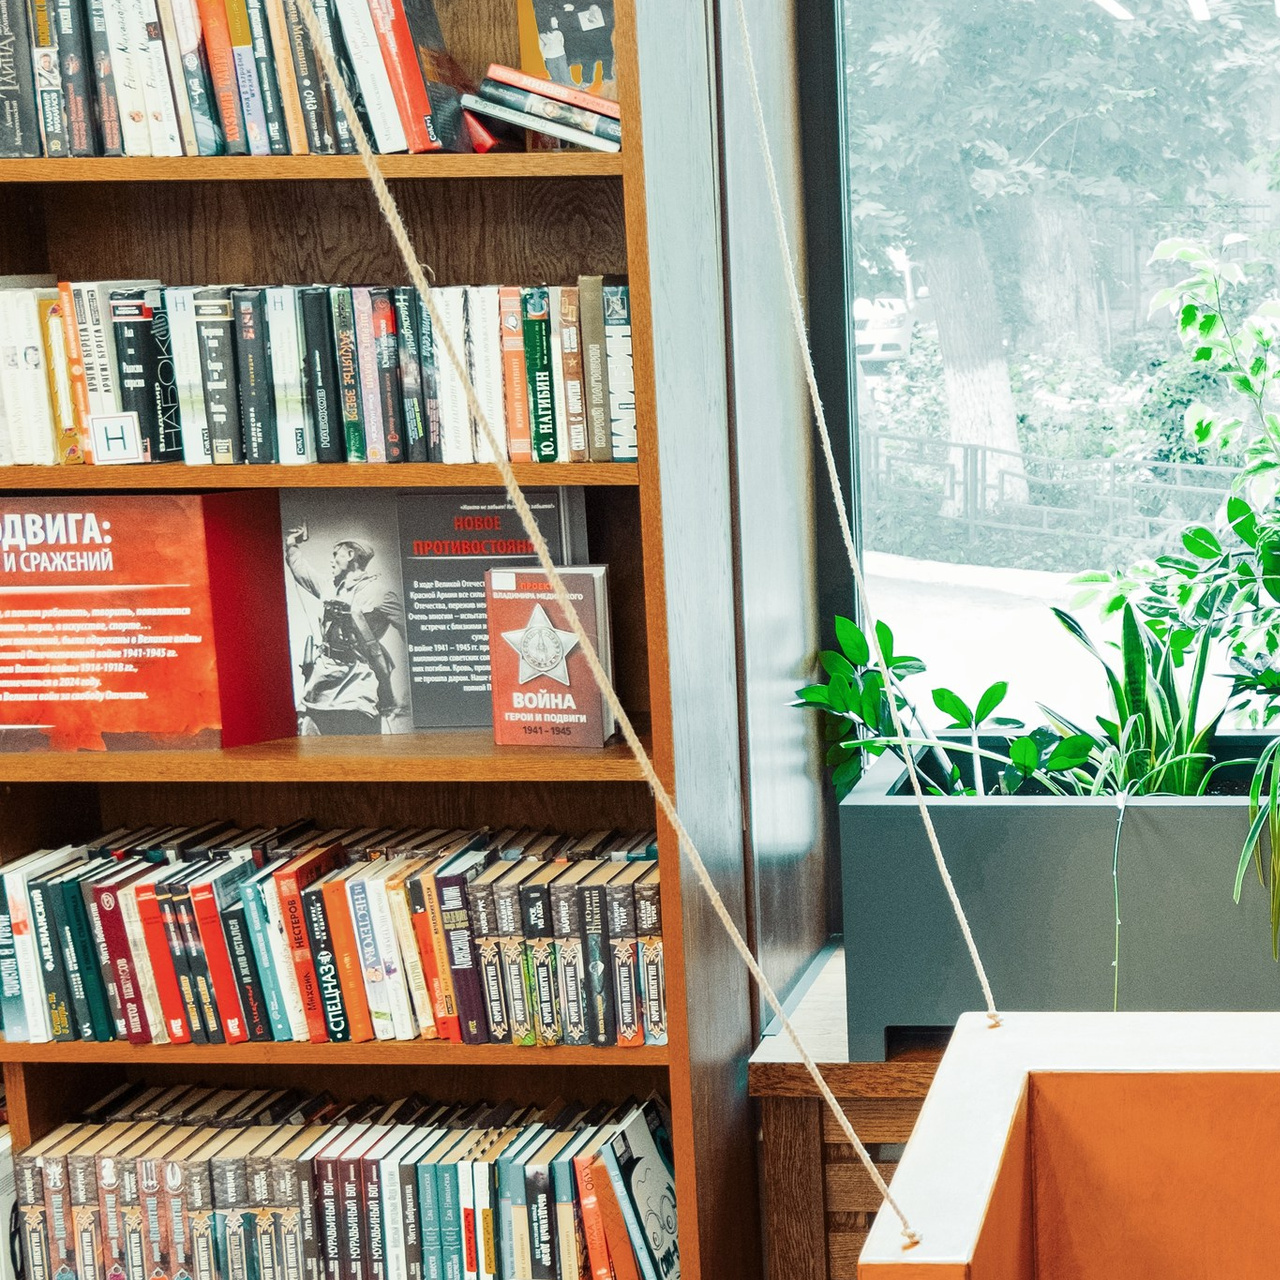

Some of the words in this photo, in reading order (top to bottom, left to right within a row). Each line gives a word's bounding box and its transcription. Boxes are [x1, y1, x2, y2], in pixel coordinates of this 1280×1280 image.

[293, 25, 309, 76] Москвина
[395, 295, 417, 355] Наваждение
[79, 327, 92, 357] БЕРЕГА
[94, 329, 107, 358] БЕРЕГА
[338, 330, 355, 385] ЗАКЛЯТЬЕ
[86, 361, 98, 392] ДРУГИЕ
[589, 344, 603, 403] НАГИБИН
[345, 389, 358, 420] ЗВЕРЯ
[536, 371, 552, 433] НАГИБИН
[605, 325, 638, 458] НАГИБИН
[155, 382, 166, 452] Владимир
[249, 407, 259, 458] АХИЛЛЕСОВА
[317, 389, 330, 448] НАБОКОВ
[592, 407, 606, 448] ЮРИЙ
[540, 438, 555, 455] Ю.
[0, 513, 112, 551] ДВИГА:
[454, 516, 501, 530] НОВОЕ
[4, 553, 16, 572] И
[19, 548, 113, 572] СРАЖЕНИЙ
[413, 539, 540, 555] ПРОТИВОСТОЯНИ
[435, 580, 460, 588] Великой
[80, 663, 124, 672] 1914-1918
[123, 648, 166, 657] 1941-1945
[59, 678, 80, 686] 2024
[512, 689, 577, 710] ВОЙНА
[505, 712, 534, 722] ГЕРОИ
[536, 714, 542, 722] И
[544, 713, 587, 723] ПОДВИГИ
[523, 726, 543, 734] 1941
[551, 726, 572, 735] 1945
[530, 907, 538, 924] ТРОЕ
[535, 901, 544, 918] ЛЕСА
[585, 891, 593, 922] Юрий
[620, 907, 628, 926] ПИР
[31, 889, 55, 971] Ф.НЕЗНАНСКИЙ
[228, 919, 245, 955] ОСТАЛСЯ
[287, 900, 305, 949] НЕСТЕРОВ
[354, 893, 377, 964] НЕСТЕРОВА
[538, 919, 545, 929] ИЗ
[117, 958, 136, 999] НЕКРАСОВ
[239, 956, 250, 975] ЖИВ
[304, 972, 317, 1011] Михаил
[486, 965, 499, 1000] НИКИТИН
[509, 964, 522, 999] НИКИТИН
[537, 966, 549, 1001] НИКИТИН
[565, 966, 577, 1001] НИКИТИН
[619, 966, 631, 1001] НИКИТИН
[647, 965, 659, 1000] НИКИТИН
[320, 964, 345, 1032] СПЕЦНАЗ
[492, 1001, 502, 1022] ЮРИЙ
[514, 1000, 525, 1020] ЮРИЙ
[541, 1002, 552, 1023] ЮРИЙ
[569, 1002, 579, 1023] ЮРИЙ
[623, 1002, 633, 1023] ЮРИЙ
[650, 1001, 659, 1021] ЮРИЙ
[127, 1003, 141, 1033] ВИКТОР
[302, 1180, 313, 1218] Бобрыкина
[324, 1181, 334, 1195] БОГ
[345, 1182, 356, 1196] БОГ
[368, 1182, 378, 1197] БОГ
[405, 1184, 416, 1223] Бобрыкина
[424, 1173, 432, 1208] Никольская
[443, 1173, 451, 1208] Никольская
[304, 1219, 313, 1240] Убить
[324, 1199, 338, 1258] МУРАВЬИНЫЙ
[345, 1200, 360, 1259] МУРАВЬИНЫЙ
[368, 1200, 382, 1259] МУРАВЬИНЫЙ
[537, 1193, 551, 1242] ОБЫДЕННЫЙ
[407, 1224, 417, 1245] Убить
